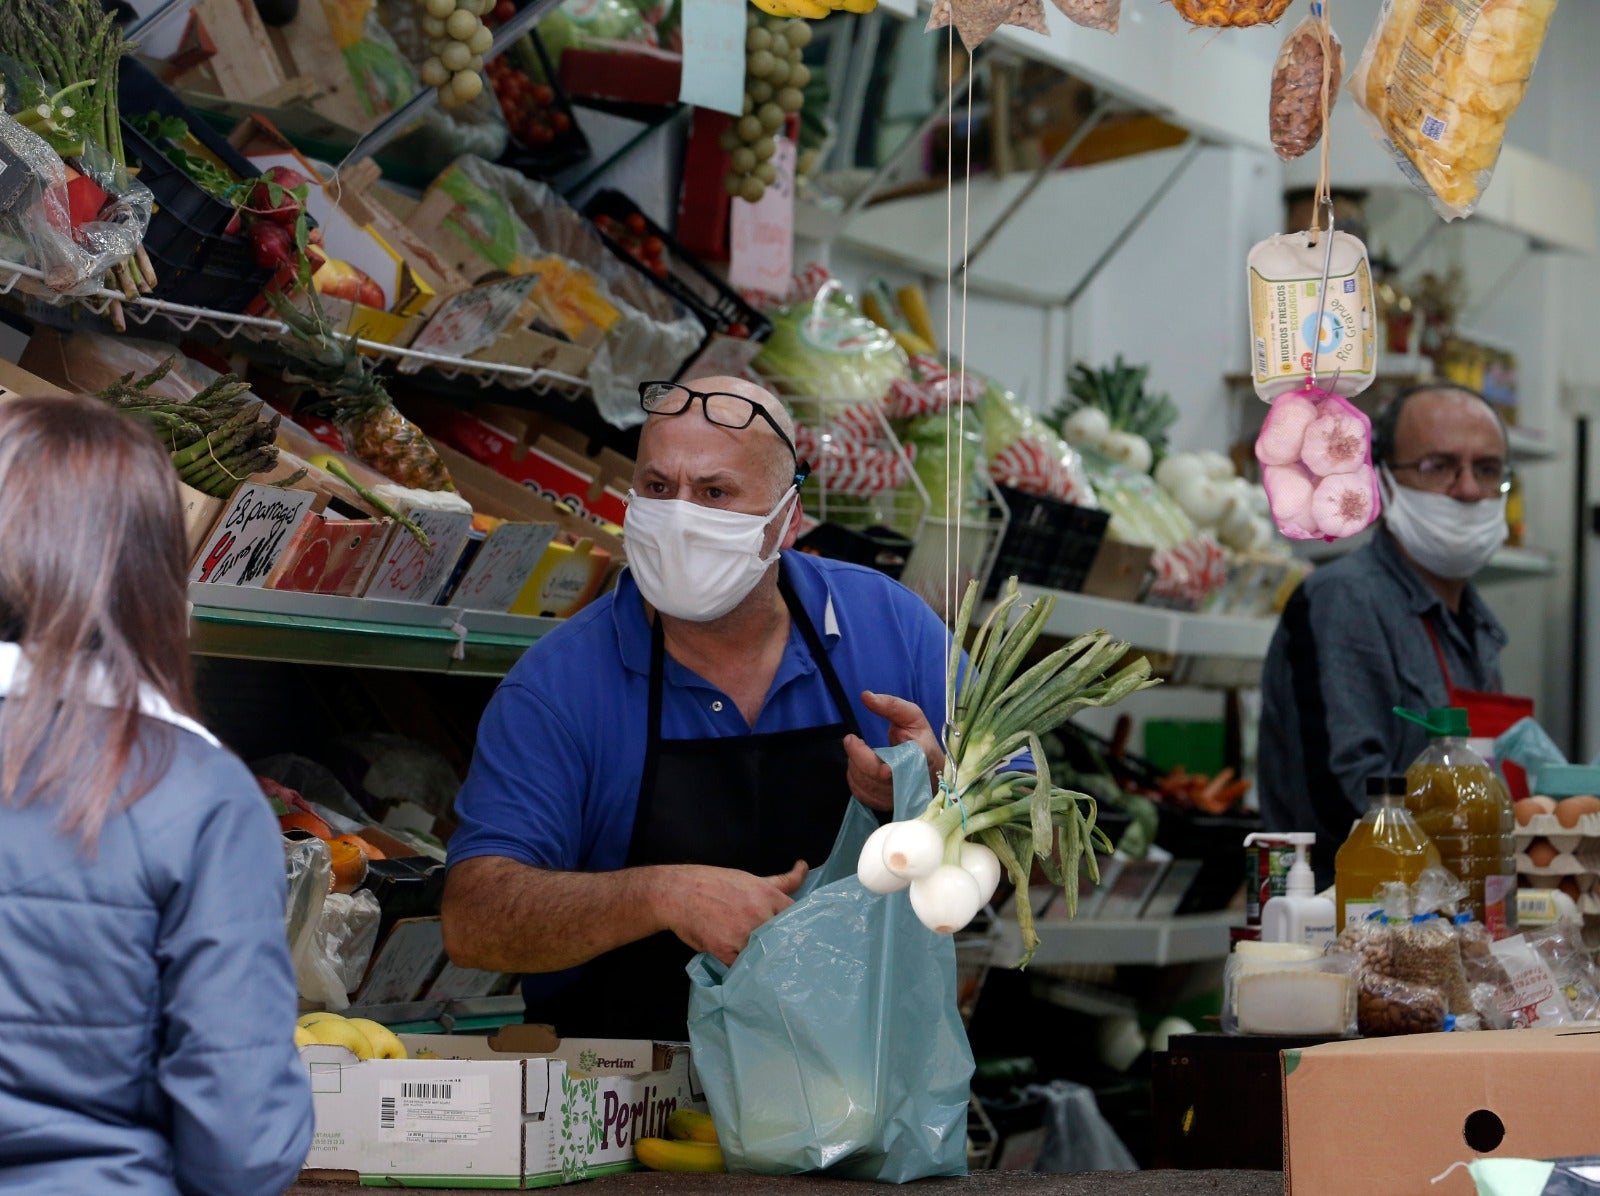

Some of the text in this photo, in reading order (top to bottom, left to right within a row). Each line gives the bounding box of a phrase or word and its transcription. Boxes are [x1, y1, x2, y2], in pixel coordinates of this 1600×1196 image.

[1276, 285, 1288, 325] FRESCOS
[1330, 298, 1357, 338] Grande
[1279, 328, 1290, 362] HUEVOS
[597, 1058, 634, 1069] Perlim
[601, 1085, 677, 1151] Perlim
